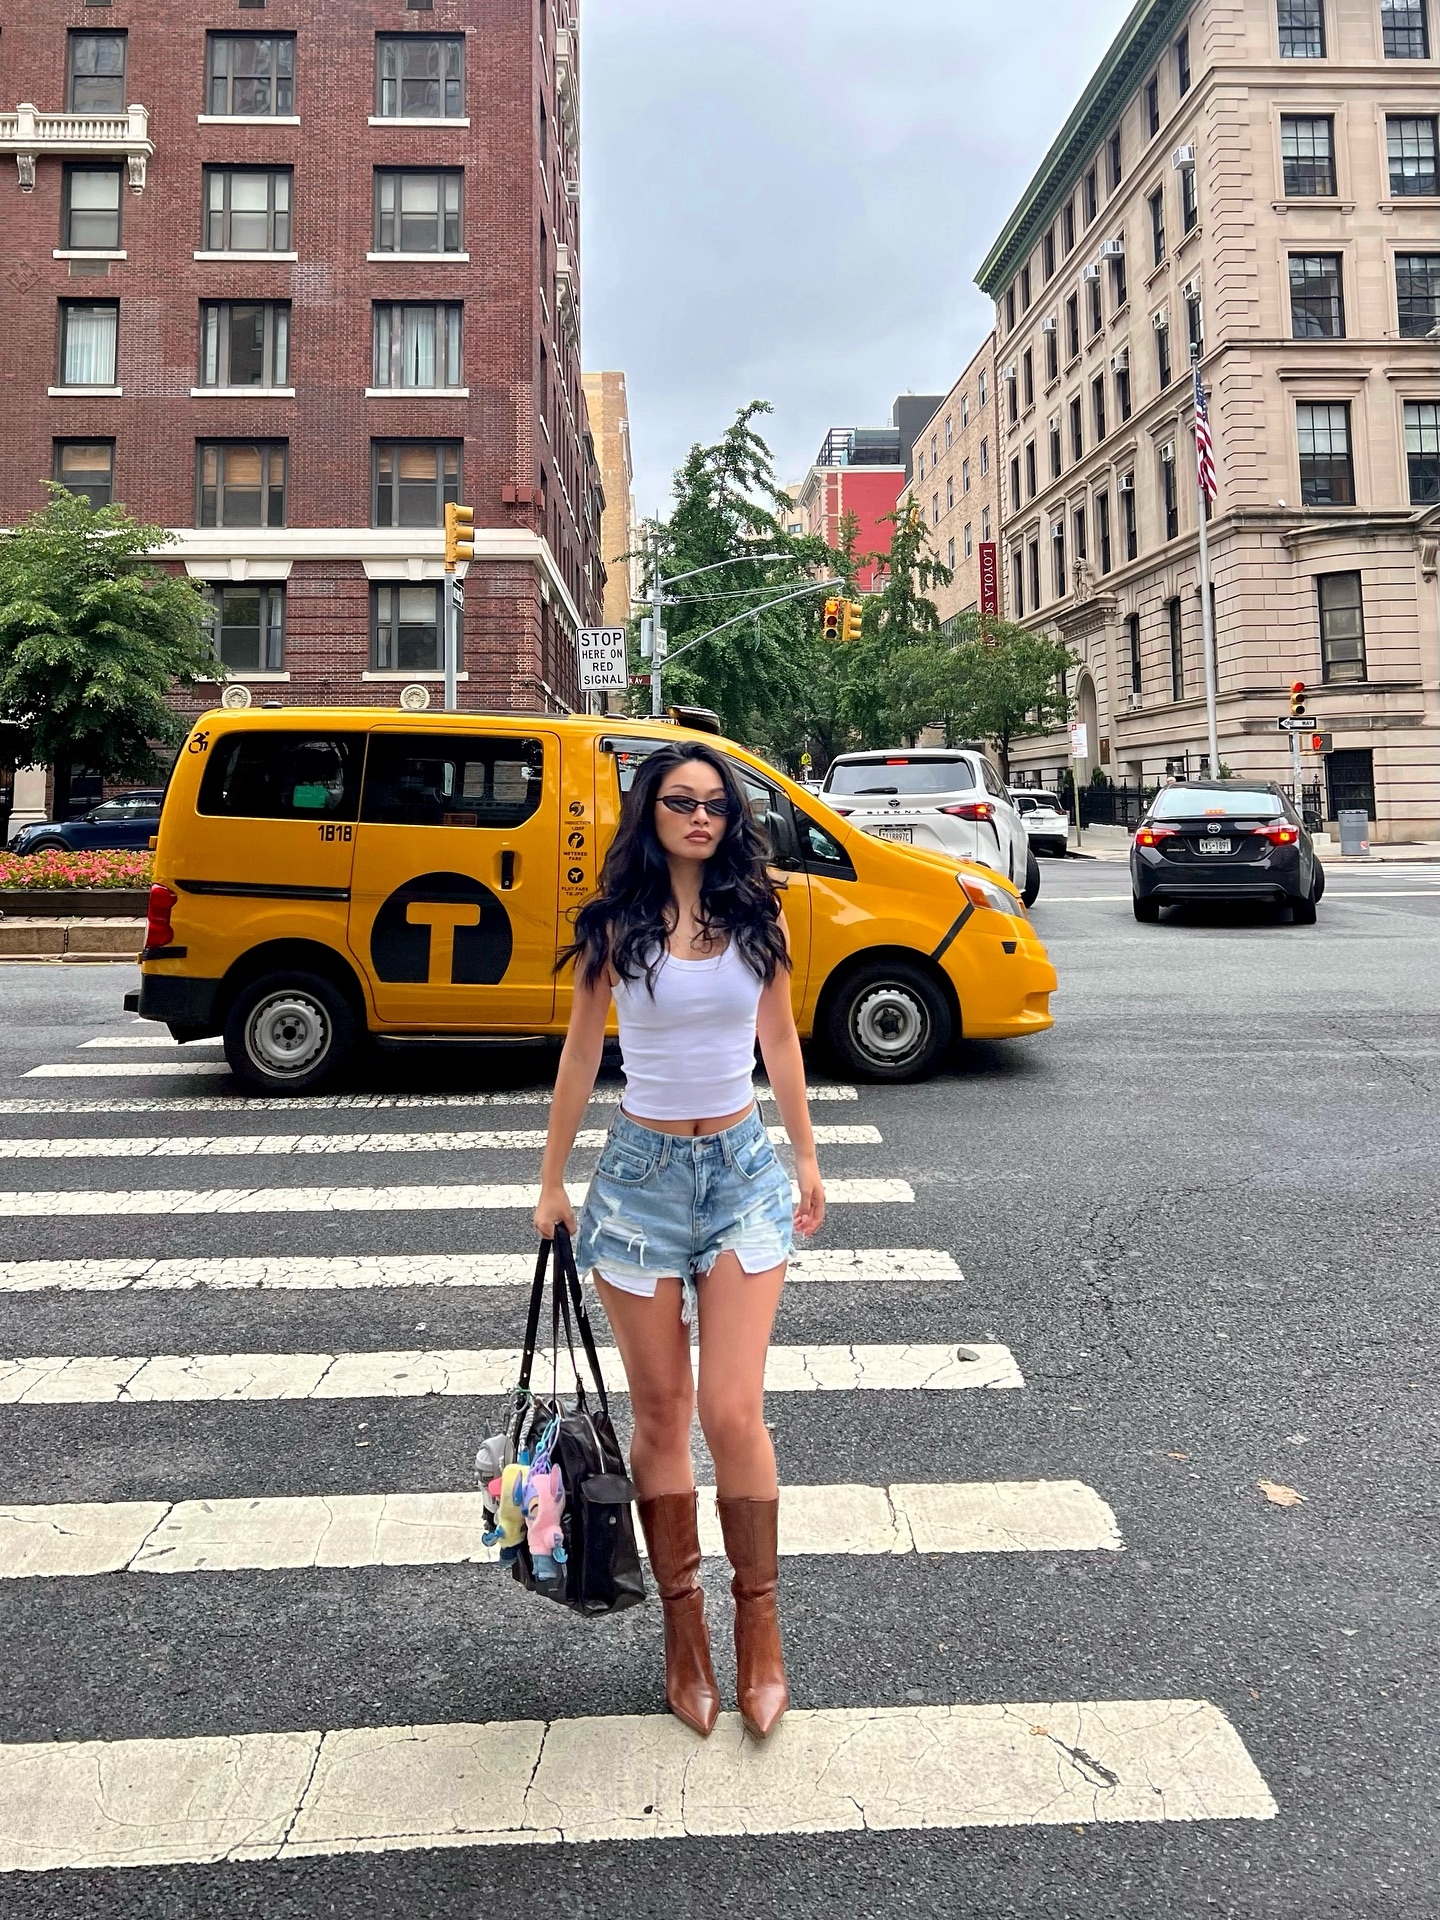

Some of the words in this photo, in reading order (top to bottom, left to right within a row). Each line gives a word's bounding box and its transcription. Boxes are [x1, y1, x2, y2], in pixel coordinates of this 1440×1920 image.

[983, 549, 994, 597] LOYOLA
[581, 632, 622, 647] STOP
[582, 649, 606, 659] HERE
[610, 648, 623, 659] ON
[592, 662, 614, 672] RED
[584, 674, 624, 685] SIGNAL
[405, 901, 481, 984] T
